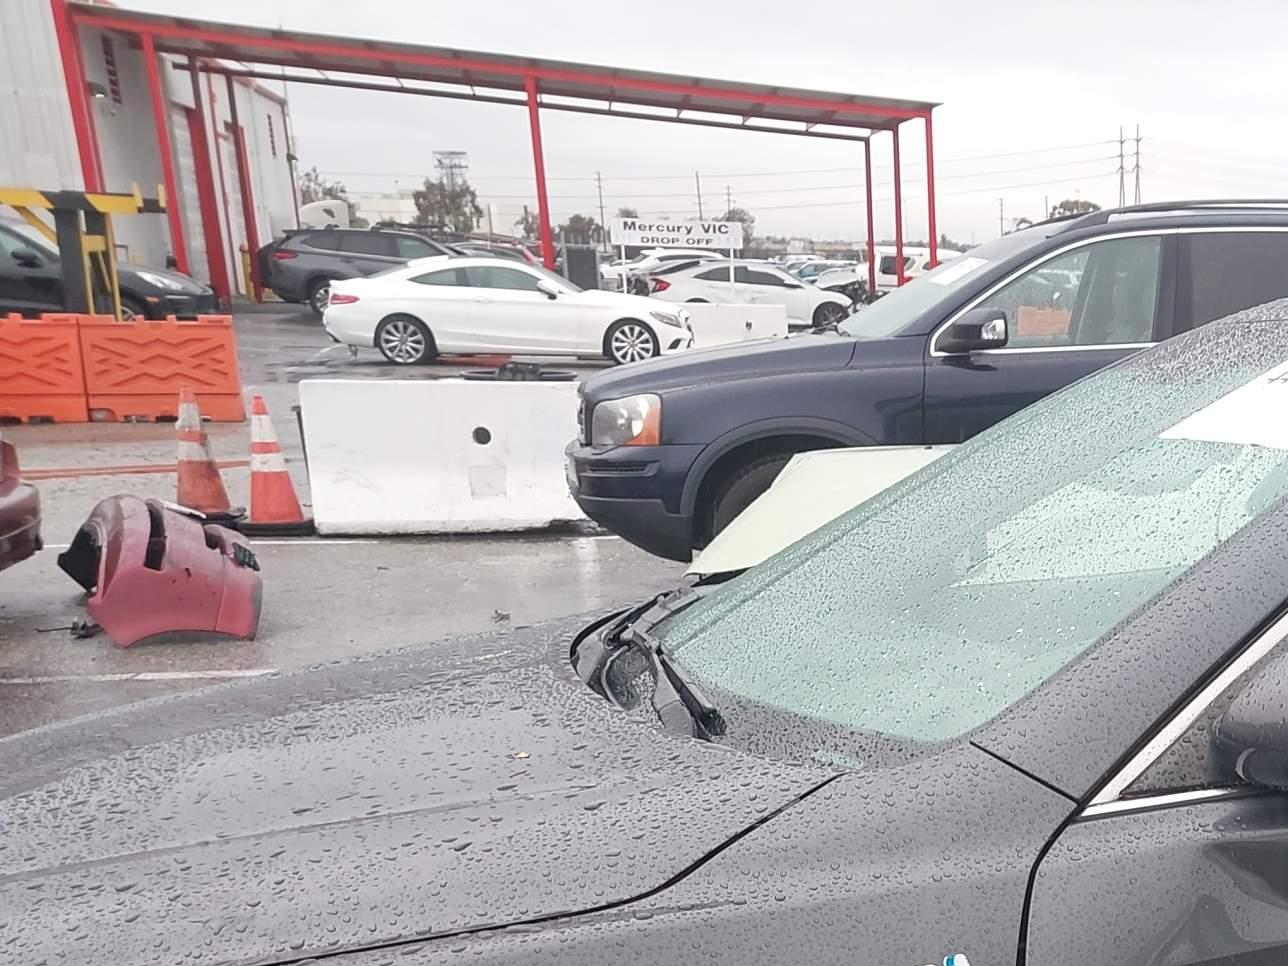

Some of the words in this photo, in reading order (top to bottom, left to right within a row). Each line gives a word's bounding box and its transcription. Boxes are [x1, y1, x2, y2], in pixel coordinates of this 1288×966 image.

[623, 221, 693, 235] Mercury
[701, 223, 729, 235] VIC
[640, 235, 680, 245] DROP
[686, 237, 714, 246] OFF
